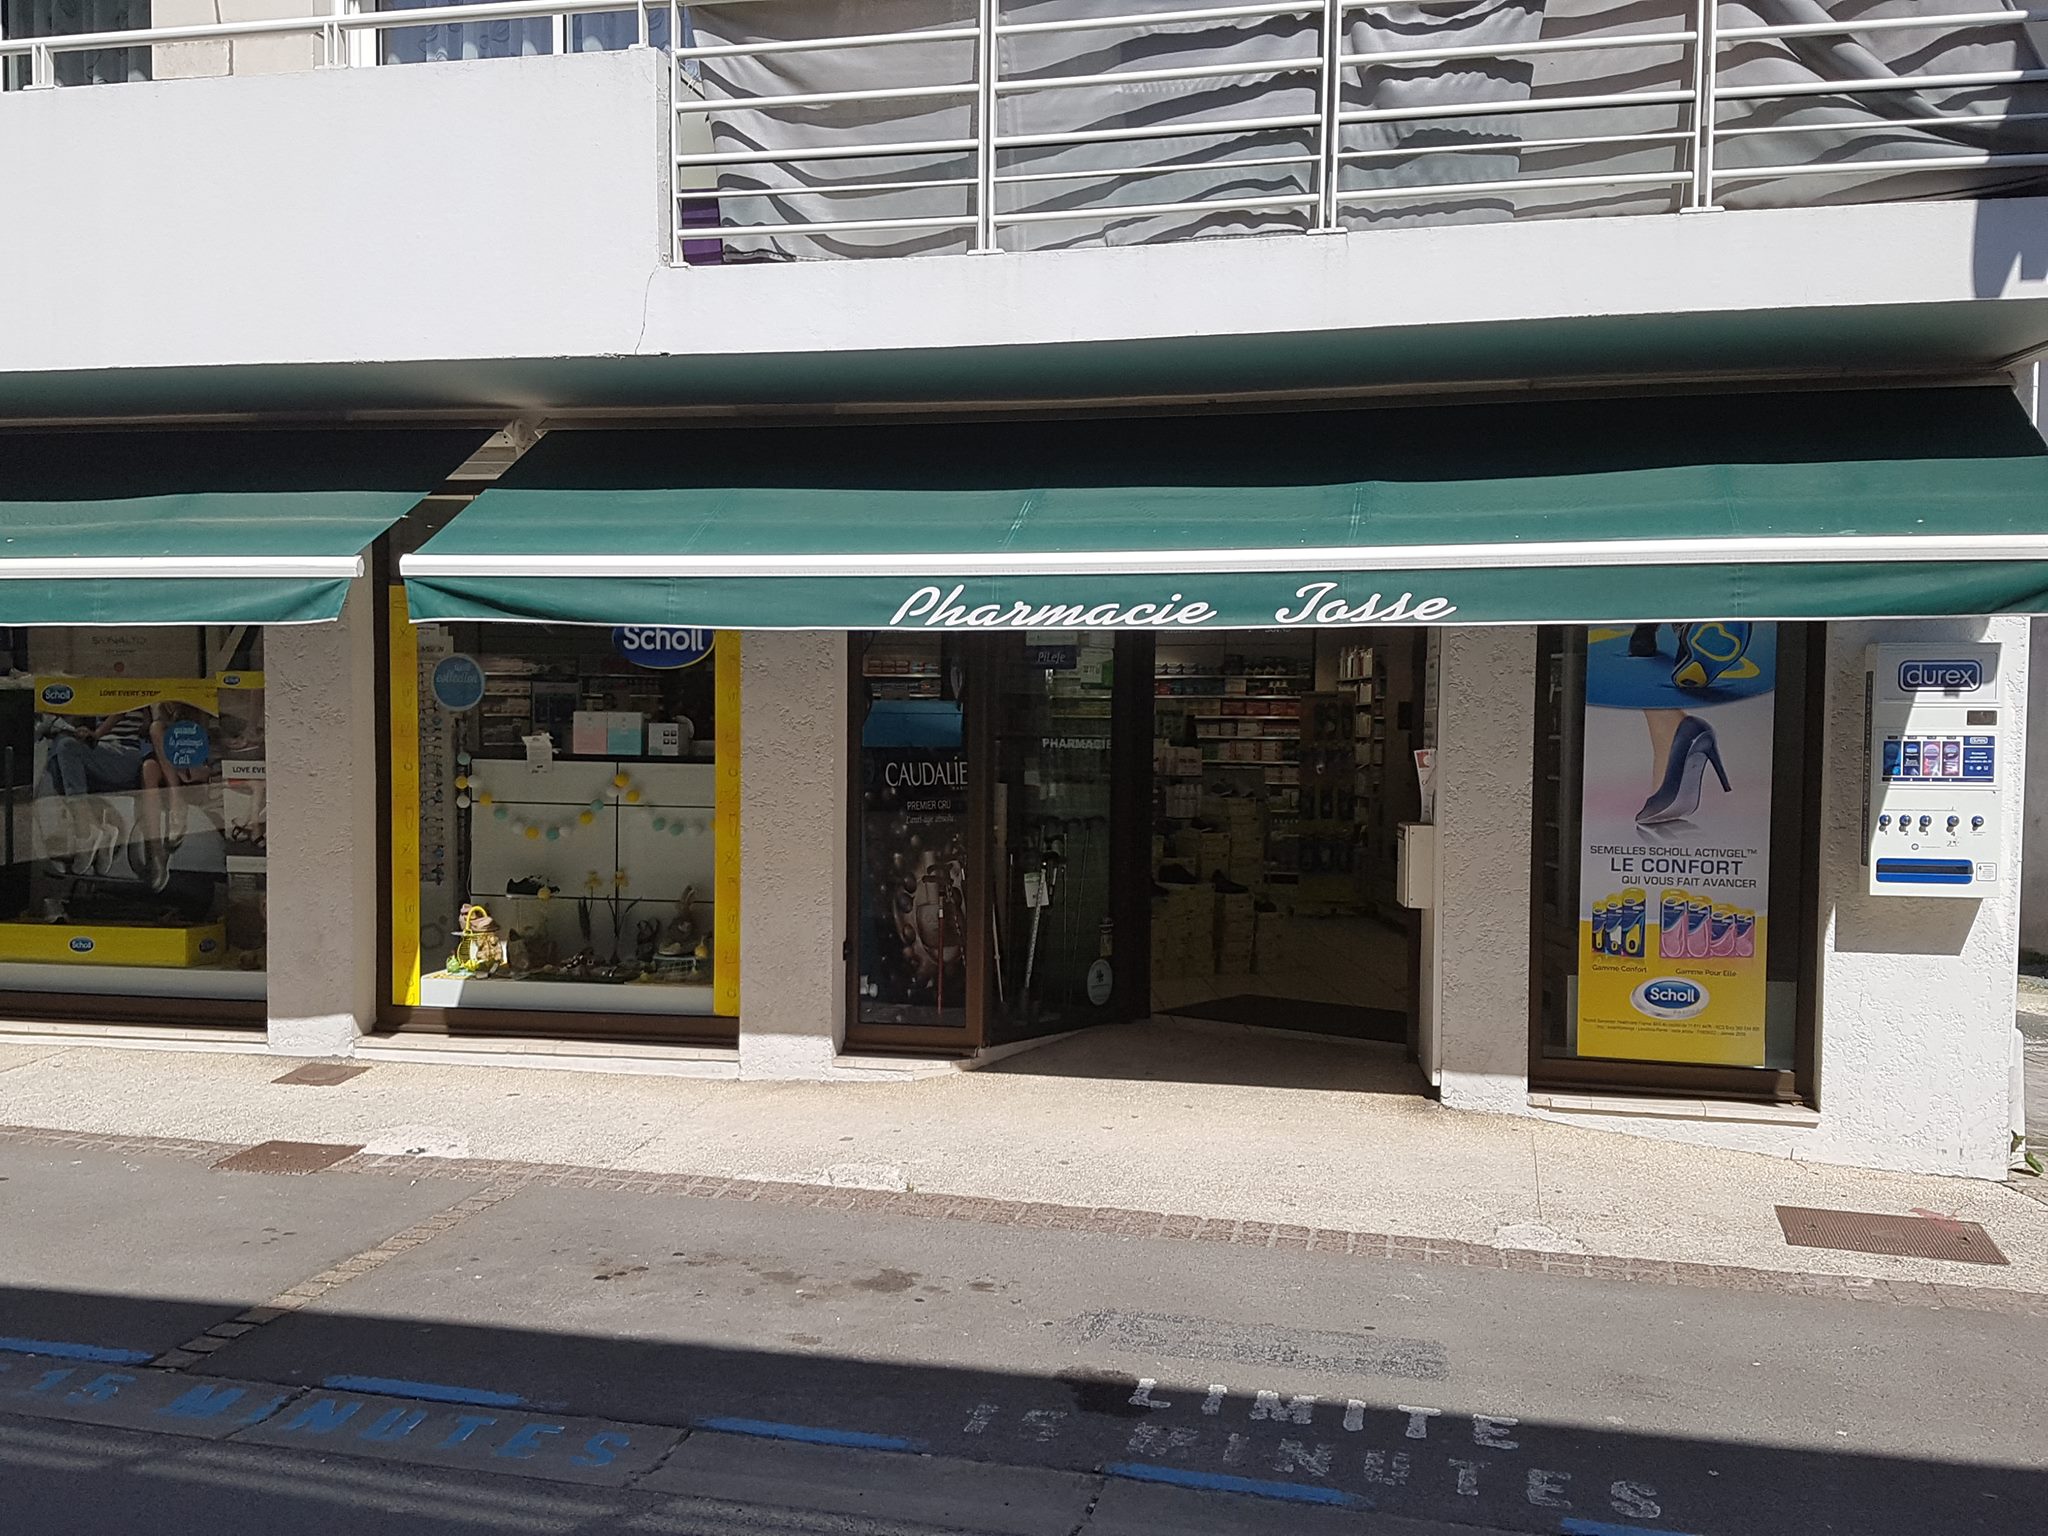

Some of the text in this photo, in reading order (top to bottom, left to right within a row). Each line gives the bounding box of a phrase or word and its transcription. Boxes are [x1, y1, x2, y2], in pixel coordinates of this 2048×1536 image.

[889, 582, 1459, 627] Pharmacie Josse
[623, 627, 704, 651] Scholl
[1906, 664, 1975, 690] durex
[45, 688, 71, 699] Scholl
[99, 689, 117, 697] LOVE
[118, 689, 140, 697] EVERY
[173, 723, 198, 736] quand
[1042, 738, 1112, 750] PHARMACIE
[232, 766, 250, 774] LOVE
[885, 756, 968, 787] CAUDALIE
[907, 800, 951, 811] PREMIER CRU
[1590, 845, 1646, 856] SEMELLES
[1648, 846, 1691, 857] SCHOLL
[1611, 857, 1743, 876] LE CONFORT
[1621, 875, 1757, 889] QUI VOUS FAIT AVANCER
[72, 940, 92, 949] Scholl
[1592, 964, 1648, 974] Gamme Confort
[1675, 968, 1704, 977] Gamme
[1705, 969, 1721, 977] Pour
[1650, 987, 1695, 1003] Scholl
[31, 1368, 631, 1467] 15 MINUTES
[1128, 1378, 1520, 1450] LIMITE
[1127, 1421, 1661, 1519] MINUTES
